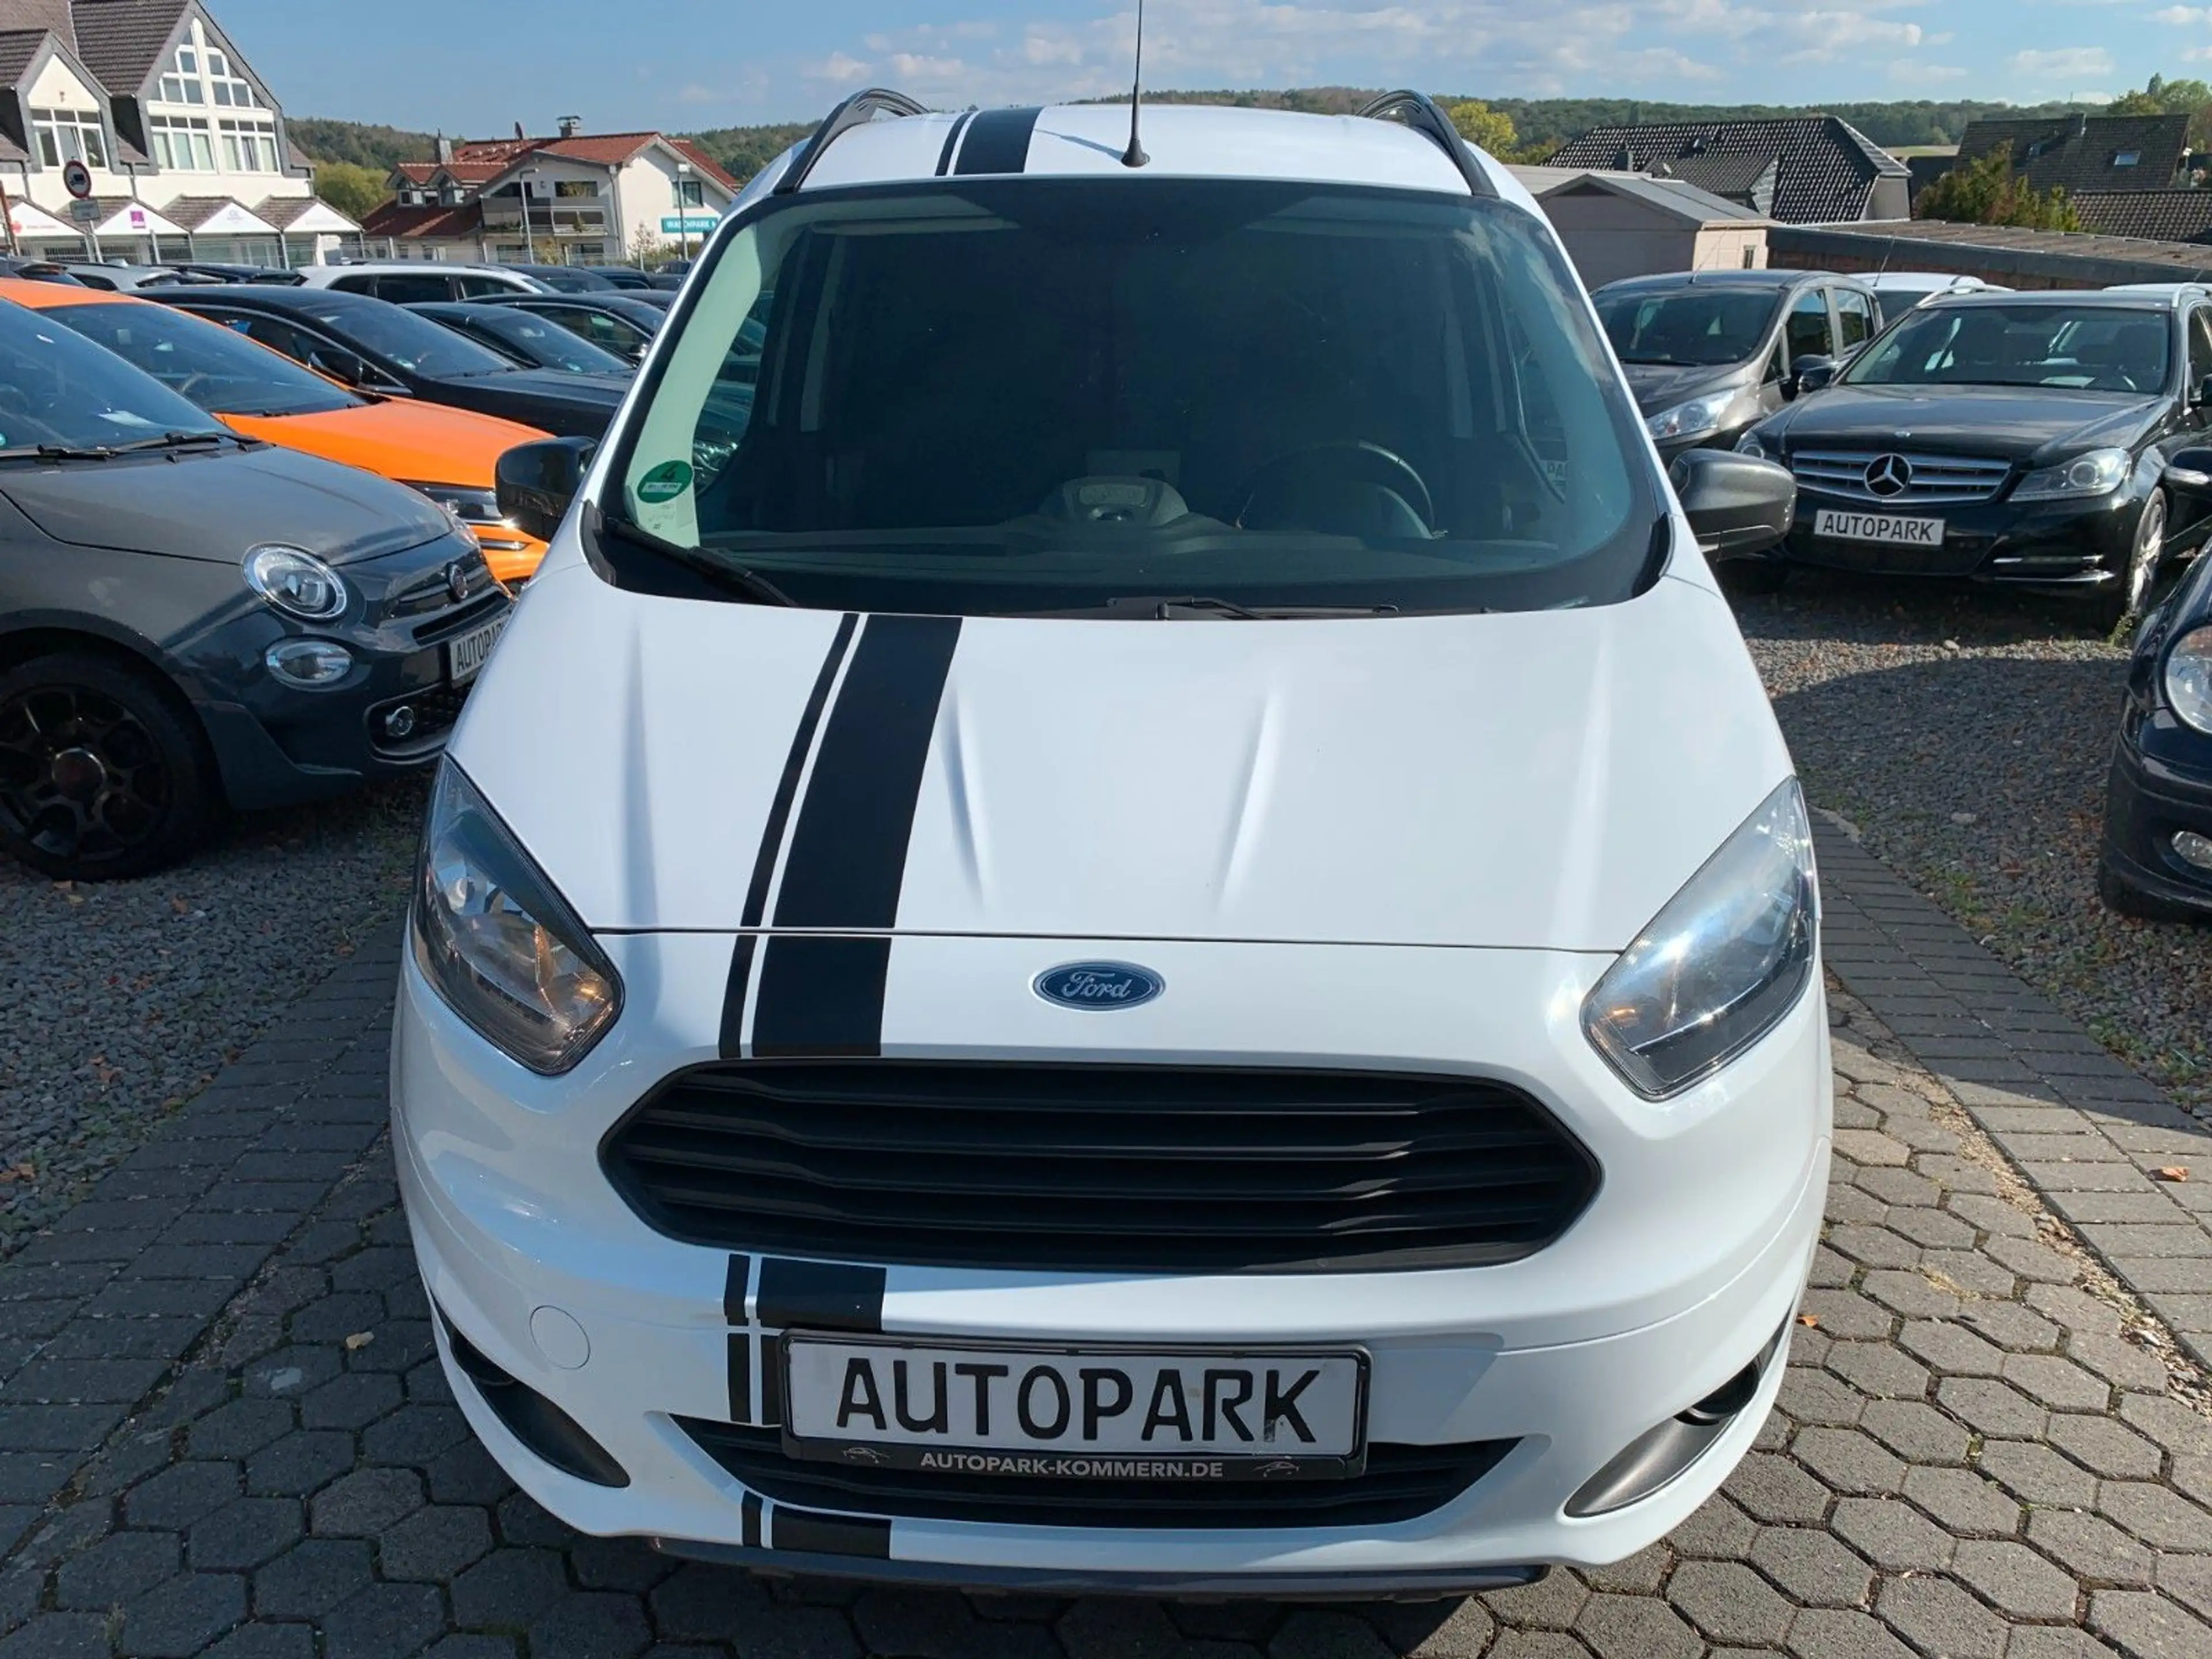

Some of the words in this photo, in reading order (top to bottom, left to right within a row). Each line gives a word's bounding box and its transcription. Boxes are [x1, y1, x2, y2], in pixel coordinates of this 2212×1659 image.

[1823, 514, 1935, 541] AUTOPARK
[1062, 971, 1132, 998] Ford
[836, 1357, 1320, 1443] AUTOPARK
[921, 1452, 1224, 1479] AUTOPARK-KOMMERN.DE
